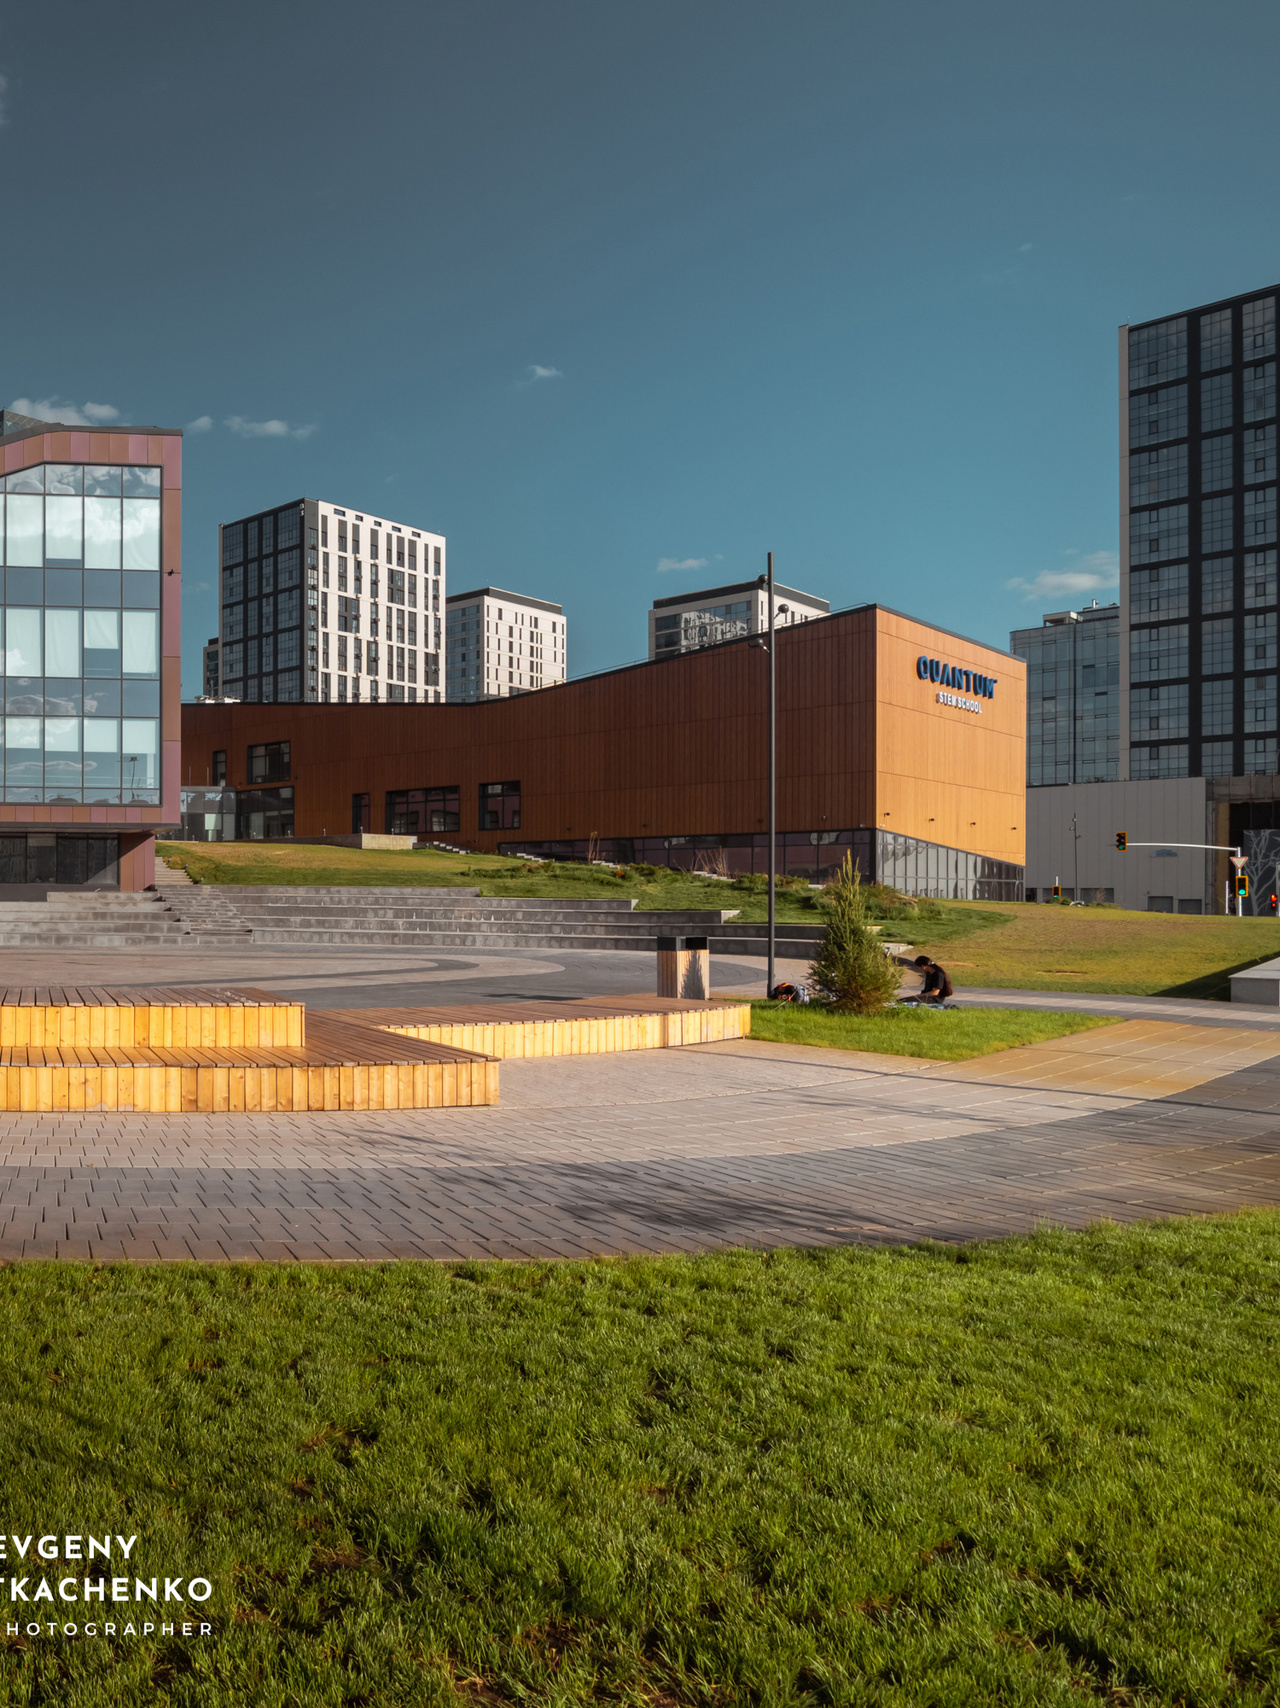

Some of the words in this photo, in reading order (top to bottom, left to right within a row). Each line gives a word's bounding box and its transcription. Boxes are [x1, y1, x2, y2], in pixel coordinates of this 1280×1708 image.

[916, 656, 997, 699] QUANTUM
[938, 692, 957, 707] STEM
[958, 697, 982, 714] SCHOOL
